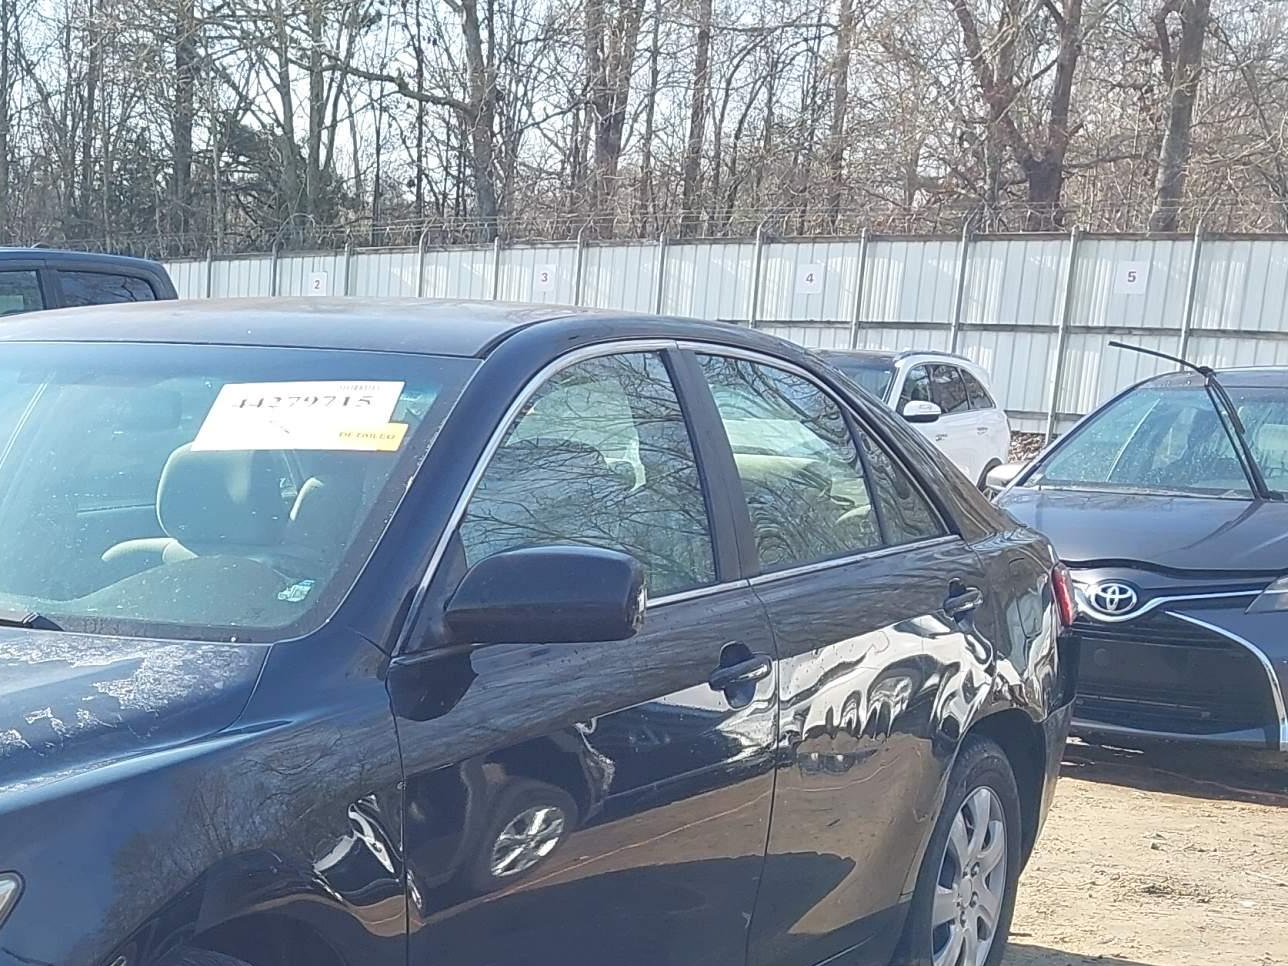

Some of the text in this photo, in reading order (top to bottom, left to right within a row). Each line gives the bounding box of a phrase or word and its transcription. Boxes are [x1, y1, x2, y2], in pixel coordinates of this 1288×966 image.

[541, 272, 548, 282] 3
[805, 273, 814, 283] 4
[1127, 271, 1137, 283] 5
[314, 280, 321, 290] 2
